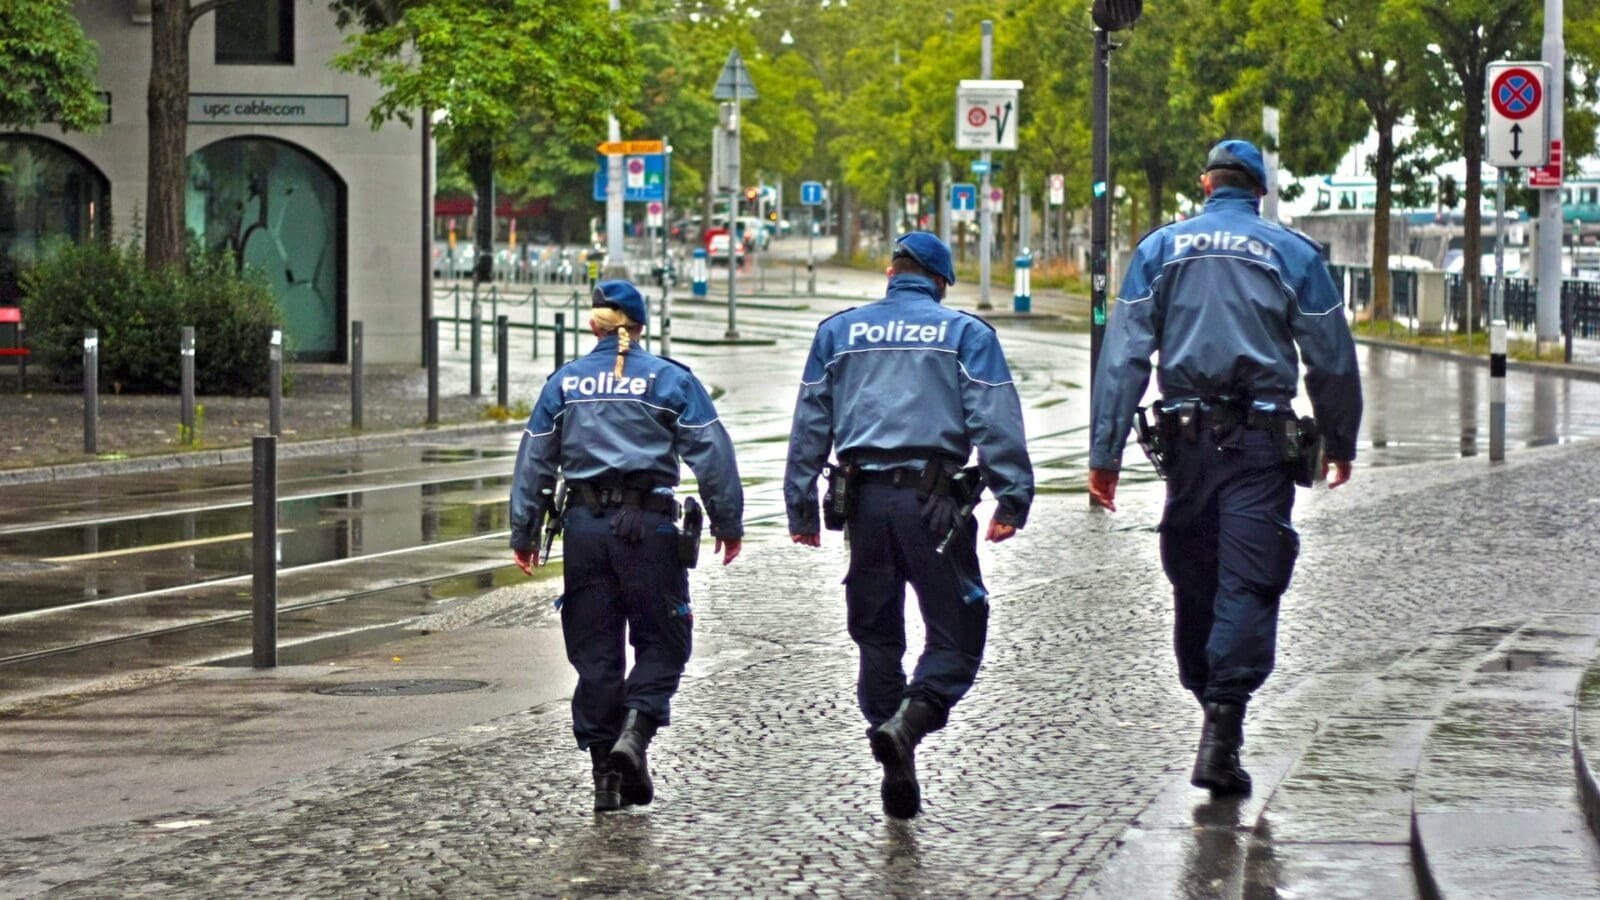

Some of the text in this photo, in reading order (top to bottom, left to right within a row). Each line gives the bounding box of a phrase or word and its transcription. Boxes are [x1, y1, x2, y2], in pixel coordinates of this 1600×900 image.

[203, 101, 305, 117] upc cablecom
[1174, 231, 1272, 259] Polizei
[848, 320, 948, 346] Polizei
